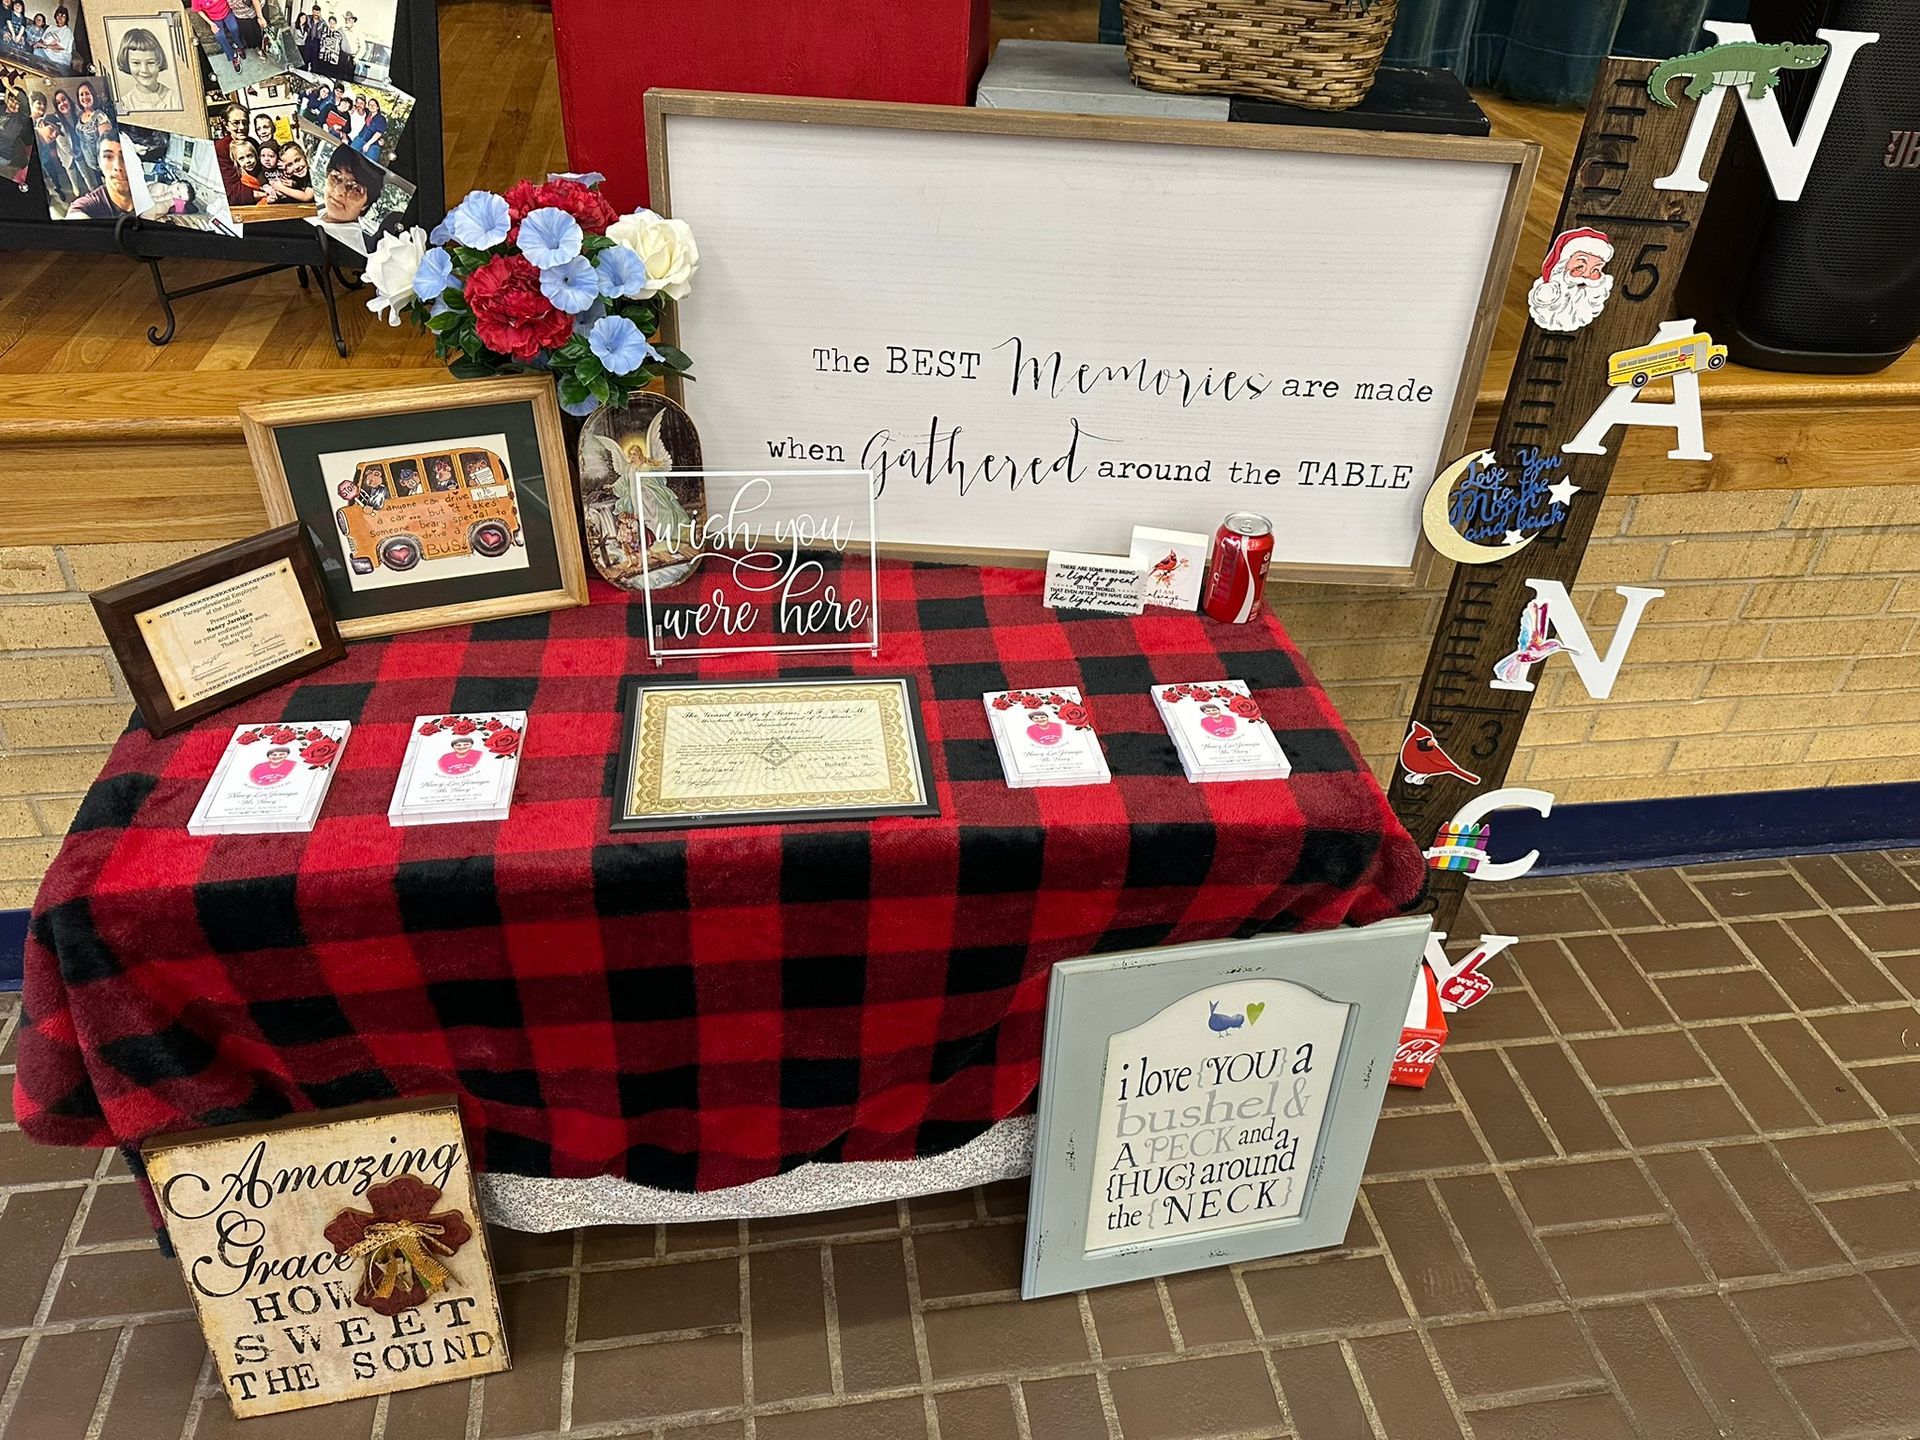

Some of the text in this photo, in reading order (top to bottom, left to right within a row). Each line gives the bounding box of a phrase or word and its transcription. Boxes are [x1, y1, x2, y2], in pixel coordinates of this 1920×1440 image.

[1621, 244, 1669, 302] 5
[813, 336, 1434, 407] The BEST Memories are made
[767, 416, 1413, 500] when Gathered around the TABLE
[1461, 447, 1562, 488] Love You
[1491, 472, 1548, 500] to the
[386, 502, 416, 514] anyone
[445, 492, 469, 503] drive
[429, 508, 444, 517] but
[450, 503, 461, 513] it
[466, 500, 497, 511] takes
[656, 478, 771, 553] wish
[1449, 484, 1540, 527] Moon
[370, 525, 410, 538] Someone
[419, 520, 447, 530] beary
[453, 510, 489, 524] special
[422, 530, 447, 539] drive
[1465, 503, 1565, 541] and back
[426, 535, 468, 556] BUS!
[1067, 570, 1098, 585] light
[1106, 575, 1139, 587] great
[182, 584, 258, 617] Paraprofessional Employee
[222, 597, 241, 608] Month
[664, 561, 868, 639] were here
[1049, 591, 1067, 601] the
[1070, 594, 1097, 607] light
[202, 633, 216, 642] your
[217, 623, 238, 636] endless
[239, 618, 253, 627] hard
[206, 610, 253, 633] Nancy Jarnigan
[209, 610, 237, 624] Presented
[217, 625, 252, 643] and support
[220, 637, 239, 648] Thank
[681, 711, 698, 719] The
[762, 710, 770, 718] of
[1471, 720, 1503, 760] 3
[1449, 984, 1476, 1005] #1
[1456, 976, 1489, 991] we're
[1394, 1038, 1441, 1064] Cola
[1119, 1063, 1129, 1101] i
[1136, 1056, 1192, 1098] love
[1292, 1042, 1313, 1075] a
[1116, 1077, 1312, 1138] bushel &
[1110, 1117, 1290, 1171] A PECK and a
[1200, 1136, 1299, 1185] around
[163, 1136, 461, 1219] Amazing
[1108, 1203, 1142, 1230] the
[191, 1210, 352, 1297] Grace
[247, 1279, 352, 1325] HOW
[234, 1296, 475, 1365] SWEET
[230, 1331, 495, 1400] THE SOUND
